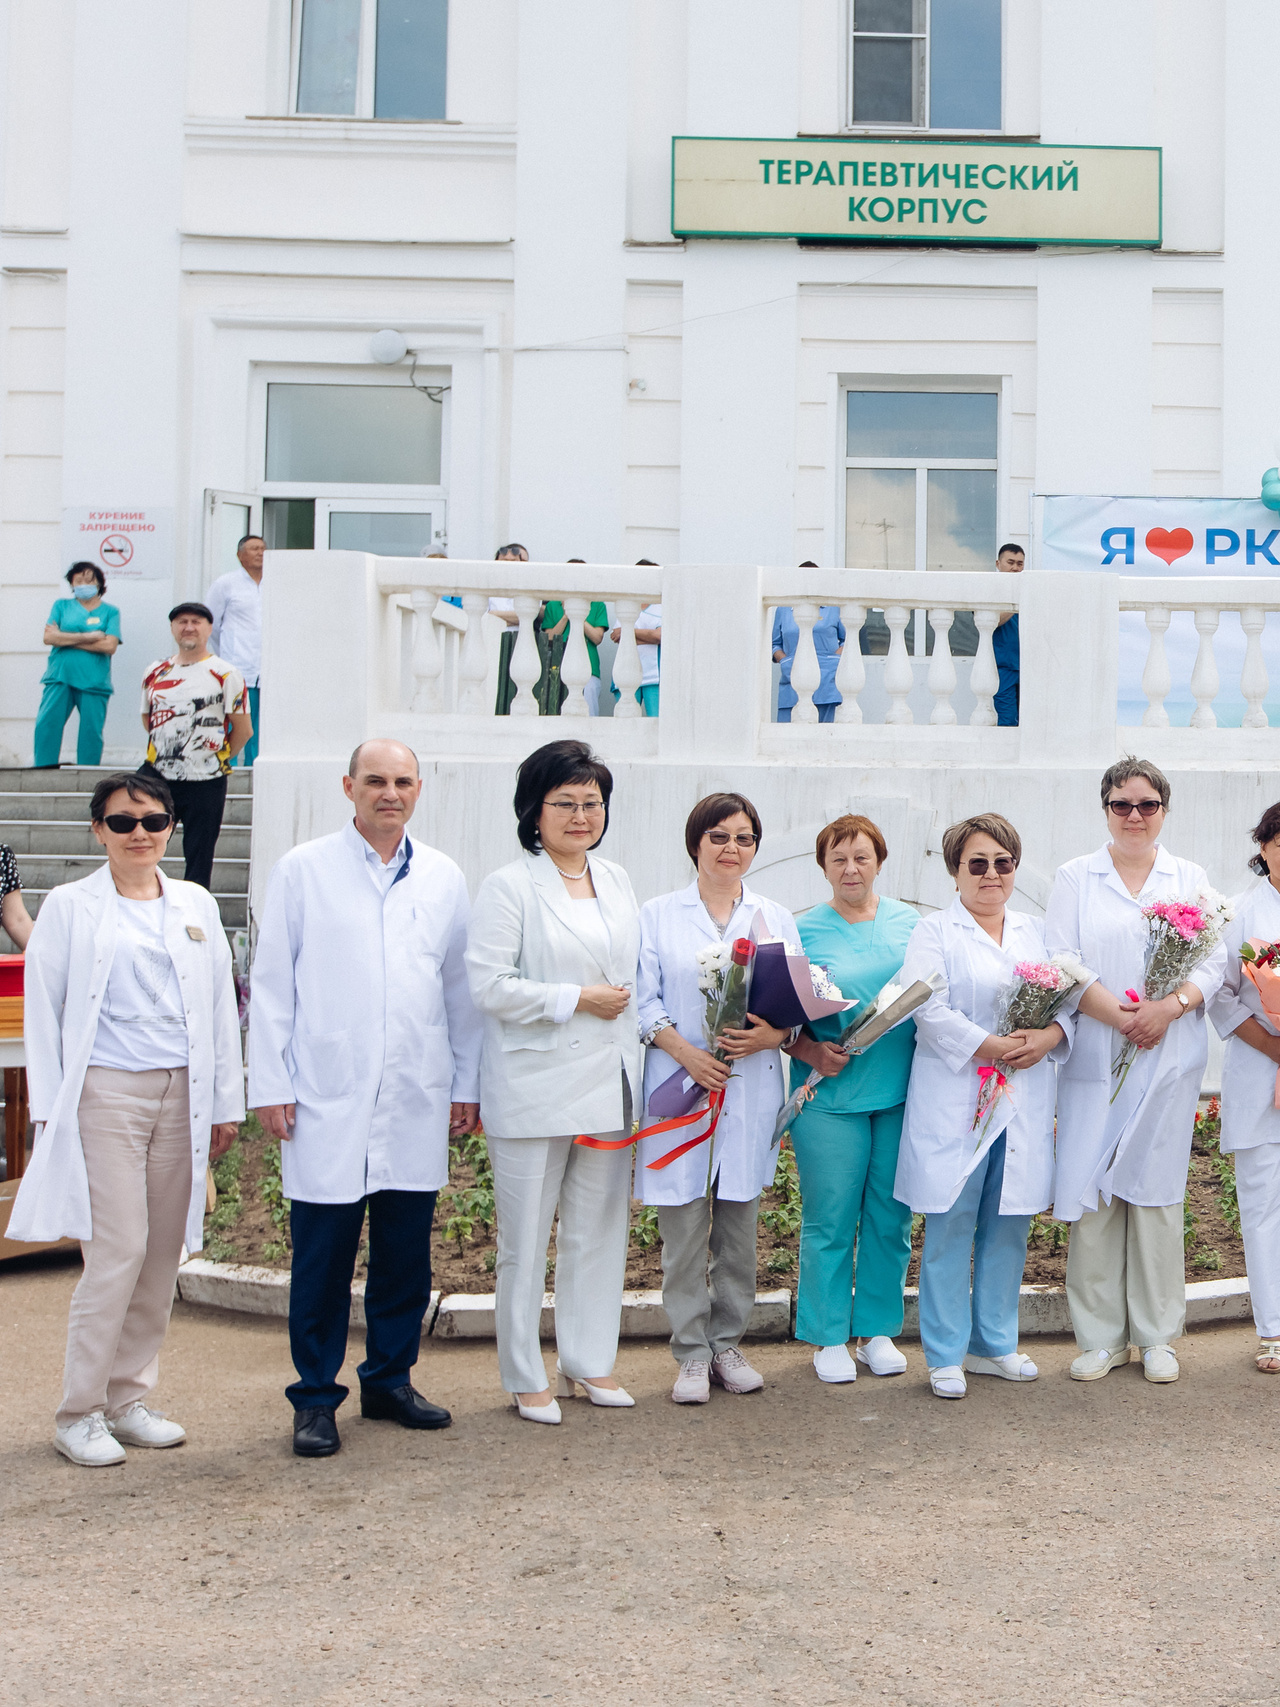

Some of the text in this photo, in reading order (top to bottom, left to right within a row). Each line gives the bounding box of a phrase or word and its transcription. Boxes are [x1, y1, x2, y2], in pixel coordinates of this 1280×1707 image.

[759, 159, 1079, 191] ТЕРАПЕВТИЧЕСКИЙ
[848, 196, 988, 224] КОРПУС
[80, 524, 155, 532] ЗАПРЕЩЕНО
[1100, 527, 1136, 565] Я
